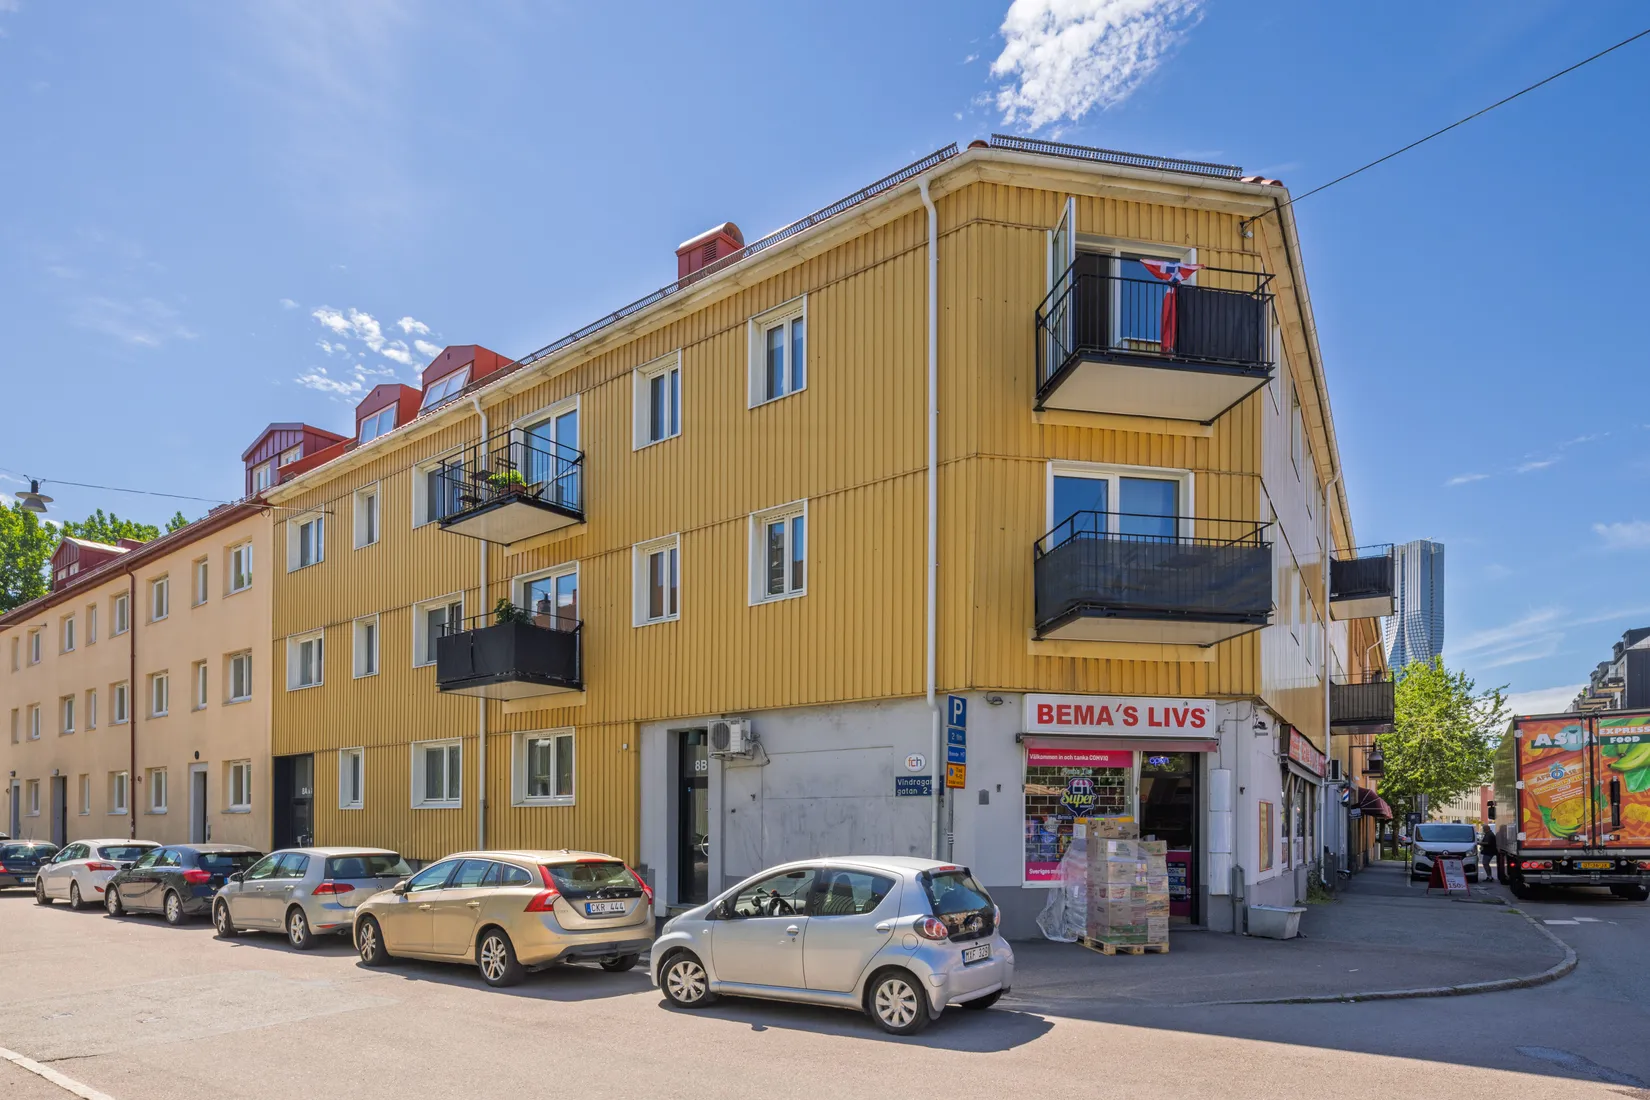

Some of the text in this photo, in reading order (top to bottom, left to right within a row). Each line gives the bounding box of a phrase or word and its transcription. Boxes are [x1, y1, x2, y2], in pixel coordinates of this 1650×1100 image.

[953, 698, 963, 724] P
[1037, 703, 1206, 729] BEMA'S LIVS
[1599, 726, 1650, 735] EXPRESS
[1534, 731, 1598, 747] ASIA
[1609, 735, 1641, 744] FOOD
[695, 760, 707, 771] 8B
[908, 756, 922, 767] fch
[897, 787, 918, 796] gatan
[1061, 789, 1097, 808] Super
[1029, 868, 1050, 876] Sveriges
[591, 902, 624, 912] CKR 444
